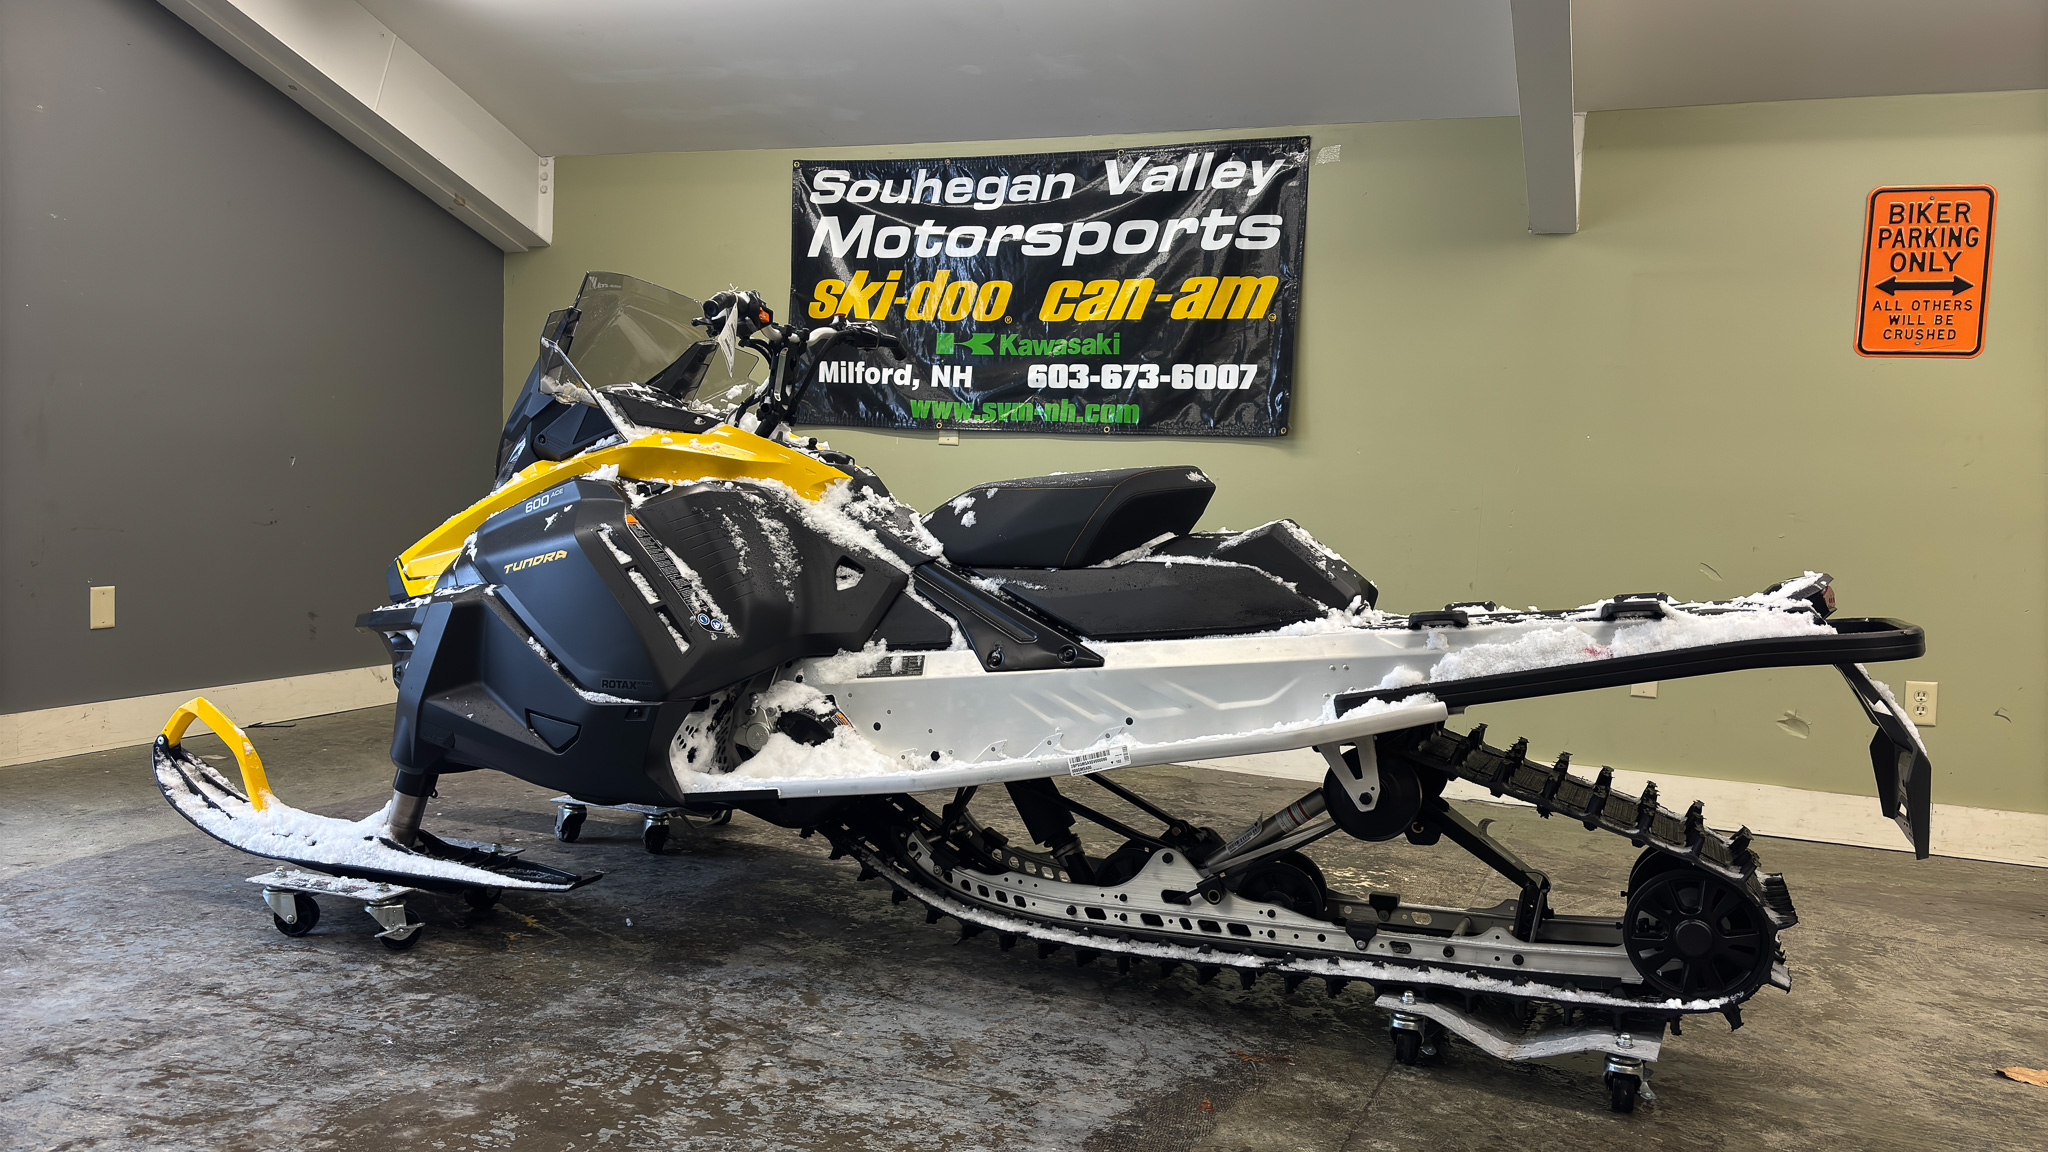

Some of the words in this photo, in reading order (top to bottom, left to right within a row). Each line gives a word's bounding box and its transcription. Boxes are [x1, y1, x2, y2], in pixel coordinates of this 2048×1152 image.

[810, 168, 1076, 211] Souhegan
[1105, 151, 1286, 196] Valley
[1889, 202, 1971, 224] BIKER
[807, 208, 1284, 266] Motorsports
[1878, 226, 1979, 249] PARKING
[1890, 251, 1963, 272] ONLY
[808, 270, 1014, 322] ski-doo
[1038, 275, 1280, 322] can-am
[1872, 300, 1903, 311] ALL
[1911, 299, 1973, 311] OTHERS
[1889, 314, 1925, 326] WILL
[1934, 314, 1954, 325] BE
[1000, 332, 1120, 356] Kawasaki
[1883, 328, 1957, 340] CRUSHED
[818, 360, 920, 391] Milford,
[930, 364, 973, 388] NH
[1027, 363, 1258, 390] 603-673-6007
[910, 398, 1140, 424] www.svm-nh.com
[525, 494, 550, 513] 600
[551, 487, 564, 498] ACE
[504, 549, 568, 574] TUNDRA
[601, 679, 637, 690] ROTAX
